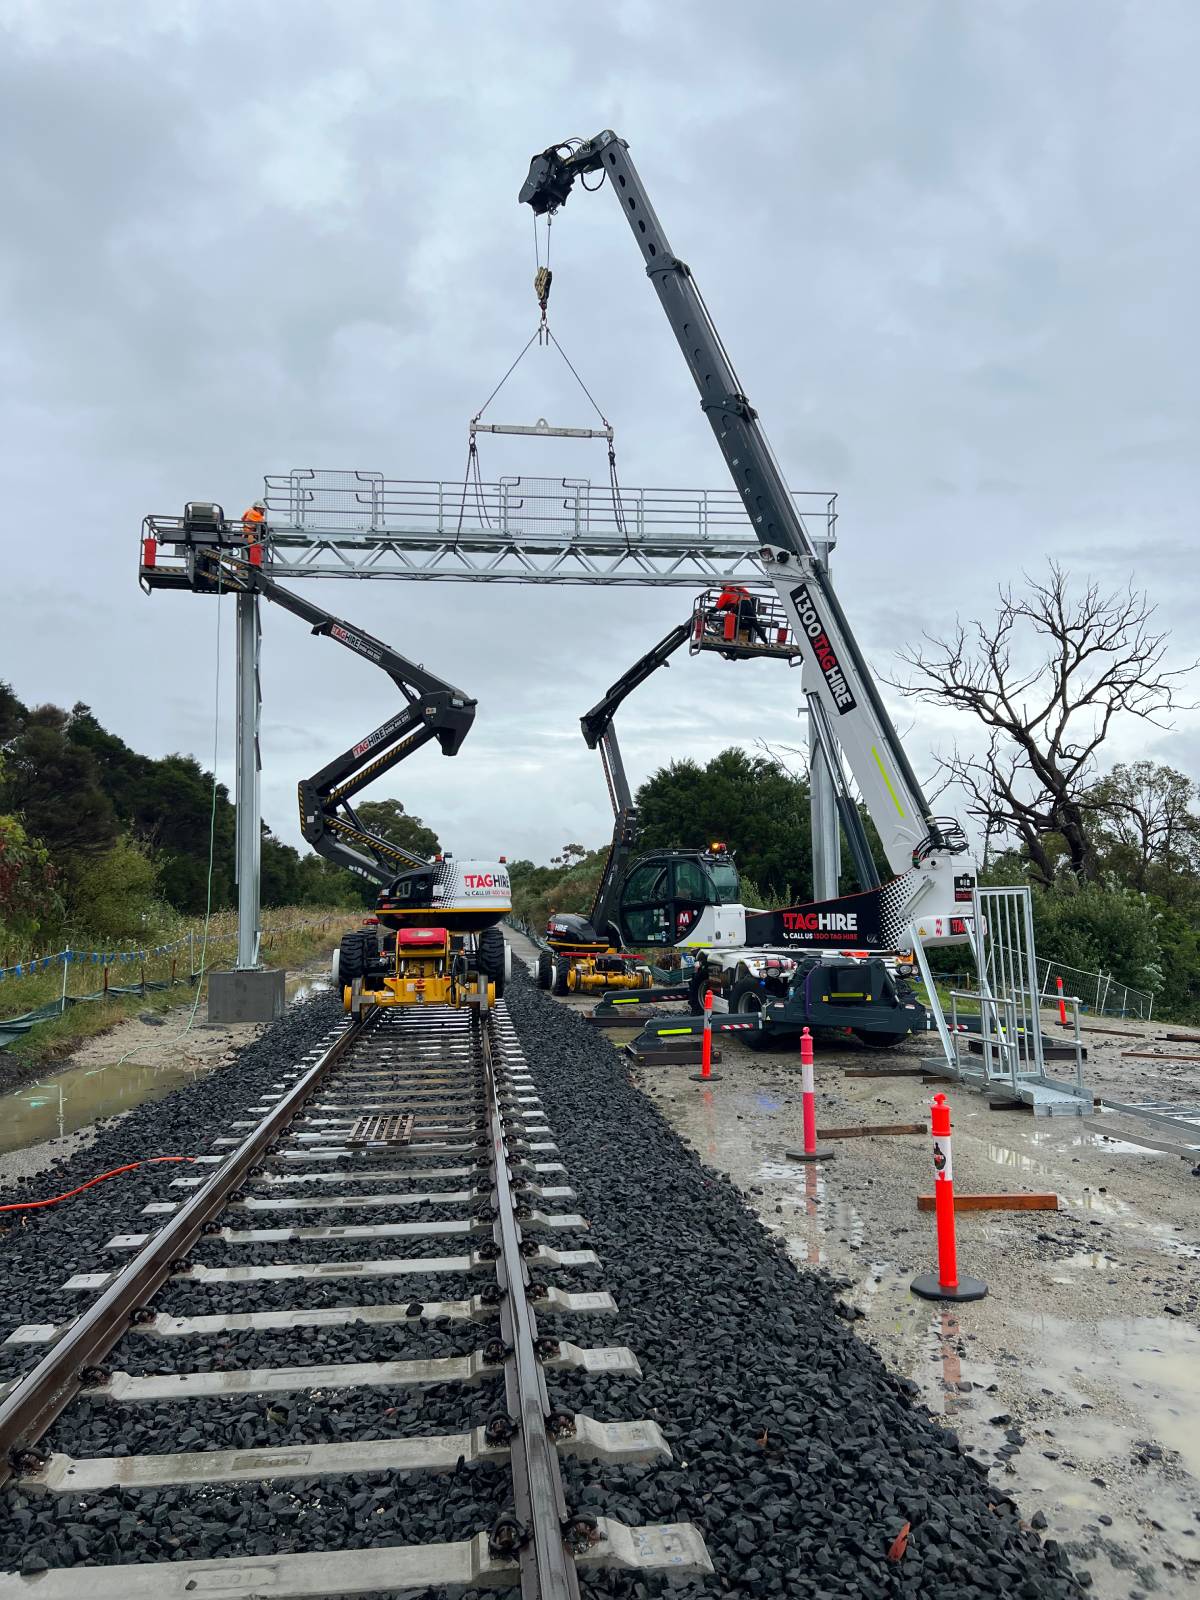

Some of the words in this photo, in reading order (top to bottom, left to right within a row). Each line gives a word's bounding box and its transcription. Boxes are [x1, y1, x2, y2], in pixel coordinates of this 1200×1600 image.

[679, 913, 689, 923] M
[789, 932, 804, 940] CALL
[804, 932, 813, 940] US
